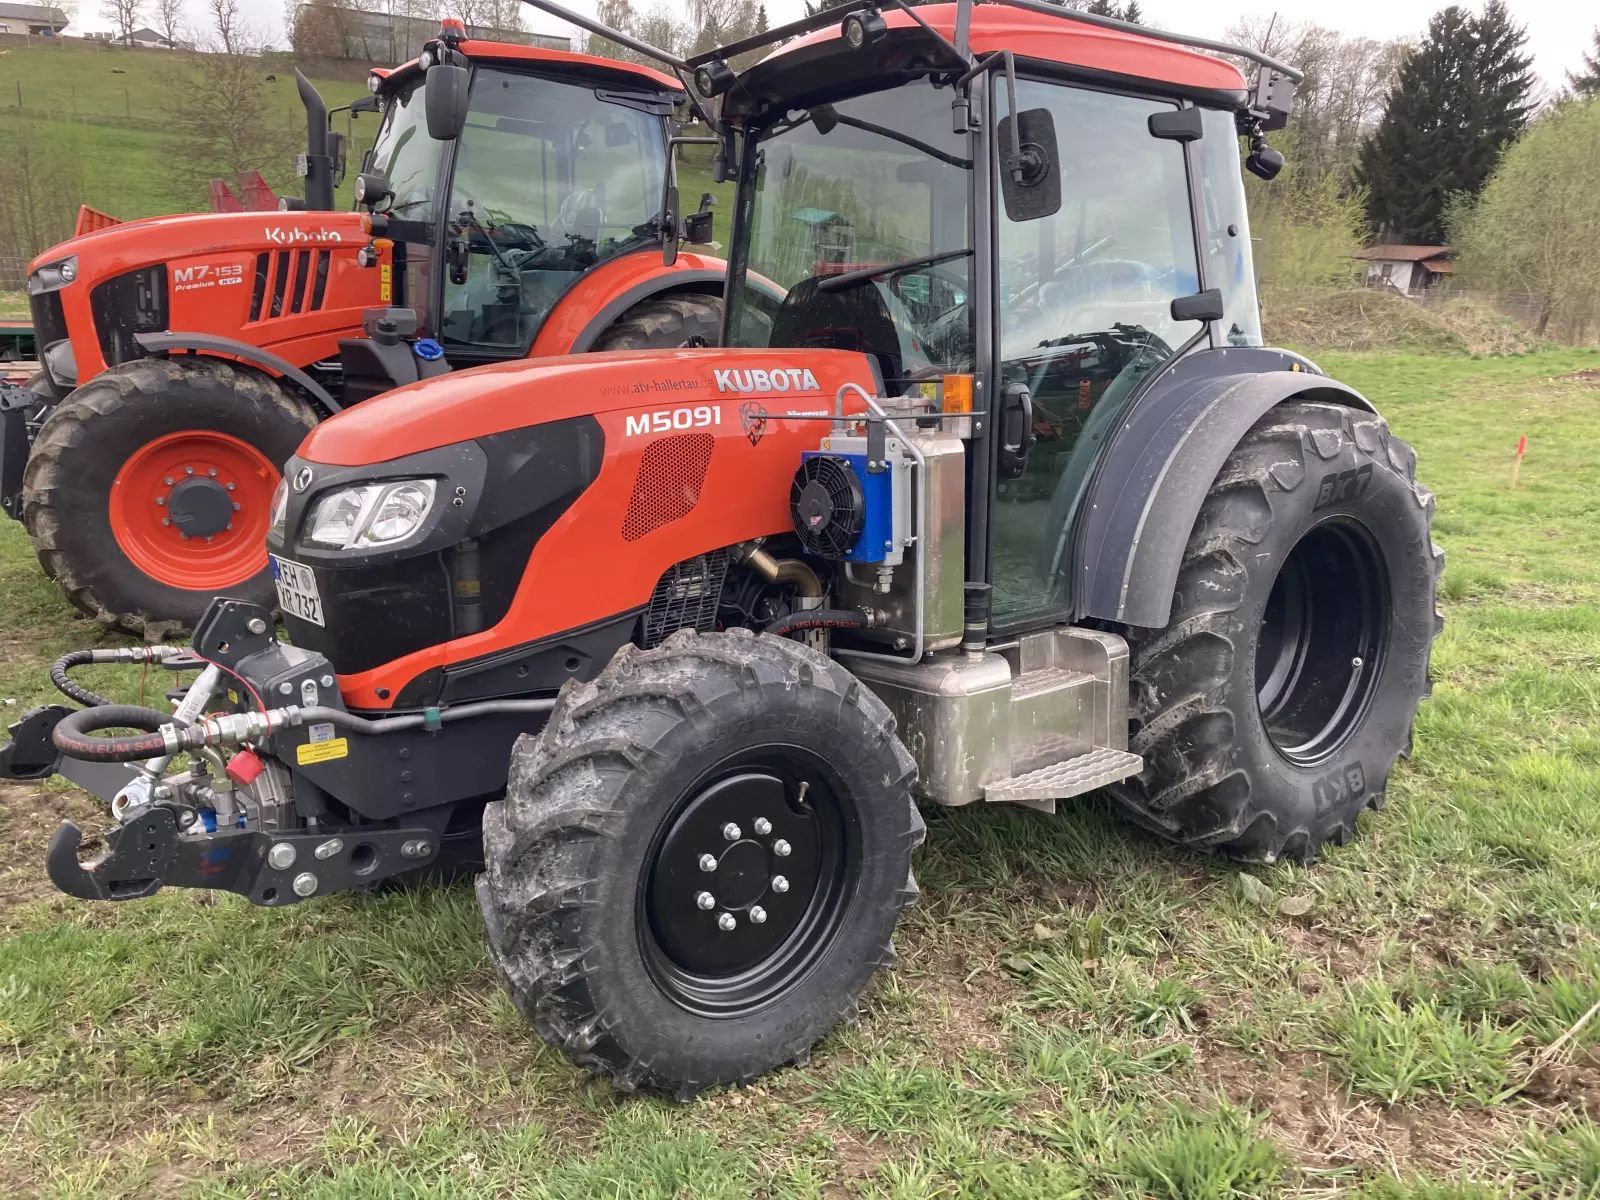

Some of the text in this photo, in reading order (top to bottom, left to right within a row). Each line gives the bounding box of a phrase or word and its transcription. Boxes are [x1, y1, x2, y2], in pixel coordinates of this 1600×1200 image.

[174, 265, 242, 283] M7-153
[175, 277, 240, 292] Premium KVT
[713, 368, 820, 393] KUBOTA
[626, 406, 720, 436] M5091
[1312, 463, 1373, 513] BKT
[295, 592, 319, 621] 732
[1312, 760, 1366, 819] BKT
